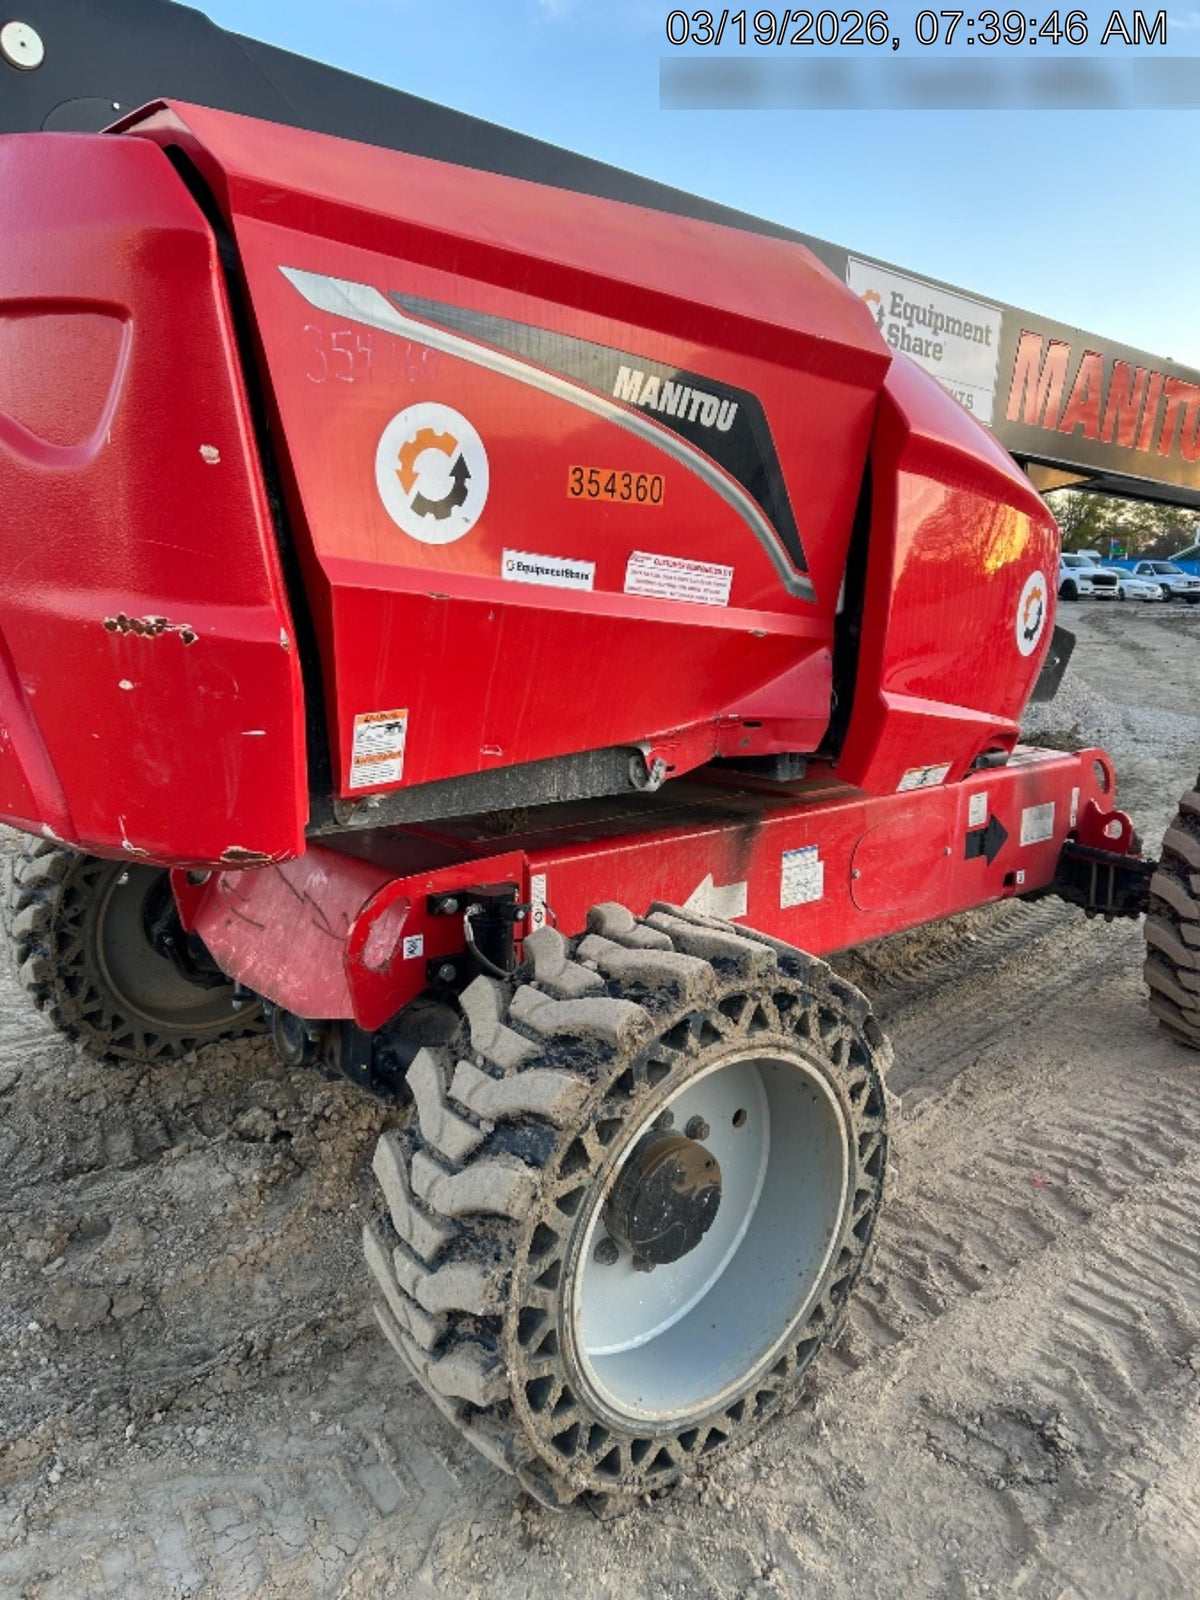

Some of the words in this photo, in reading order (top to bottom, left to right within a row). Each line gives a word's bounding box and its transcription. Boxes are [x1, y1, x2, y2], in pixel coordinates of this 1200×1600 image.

[887, 322, 944, 361] Share
[889, 291, 993, 346] Equipment
[613, 365, 738, 432] MANITOU
[570, 467, 663, 503] 354360
